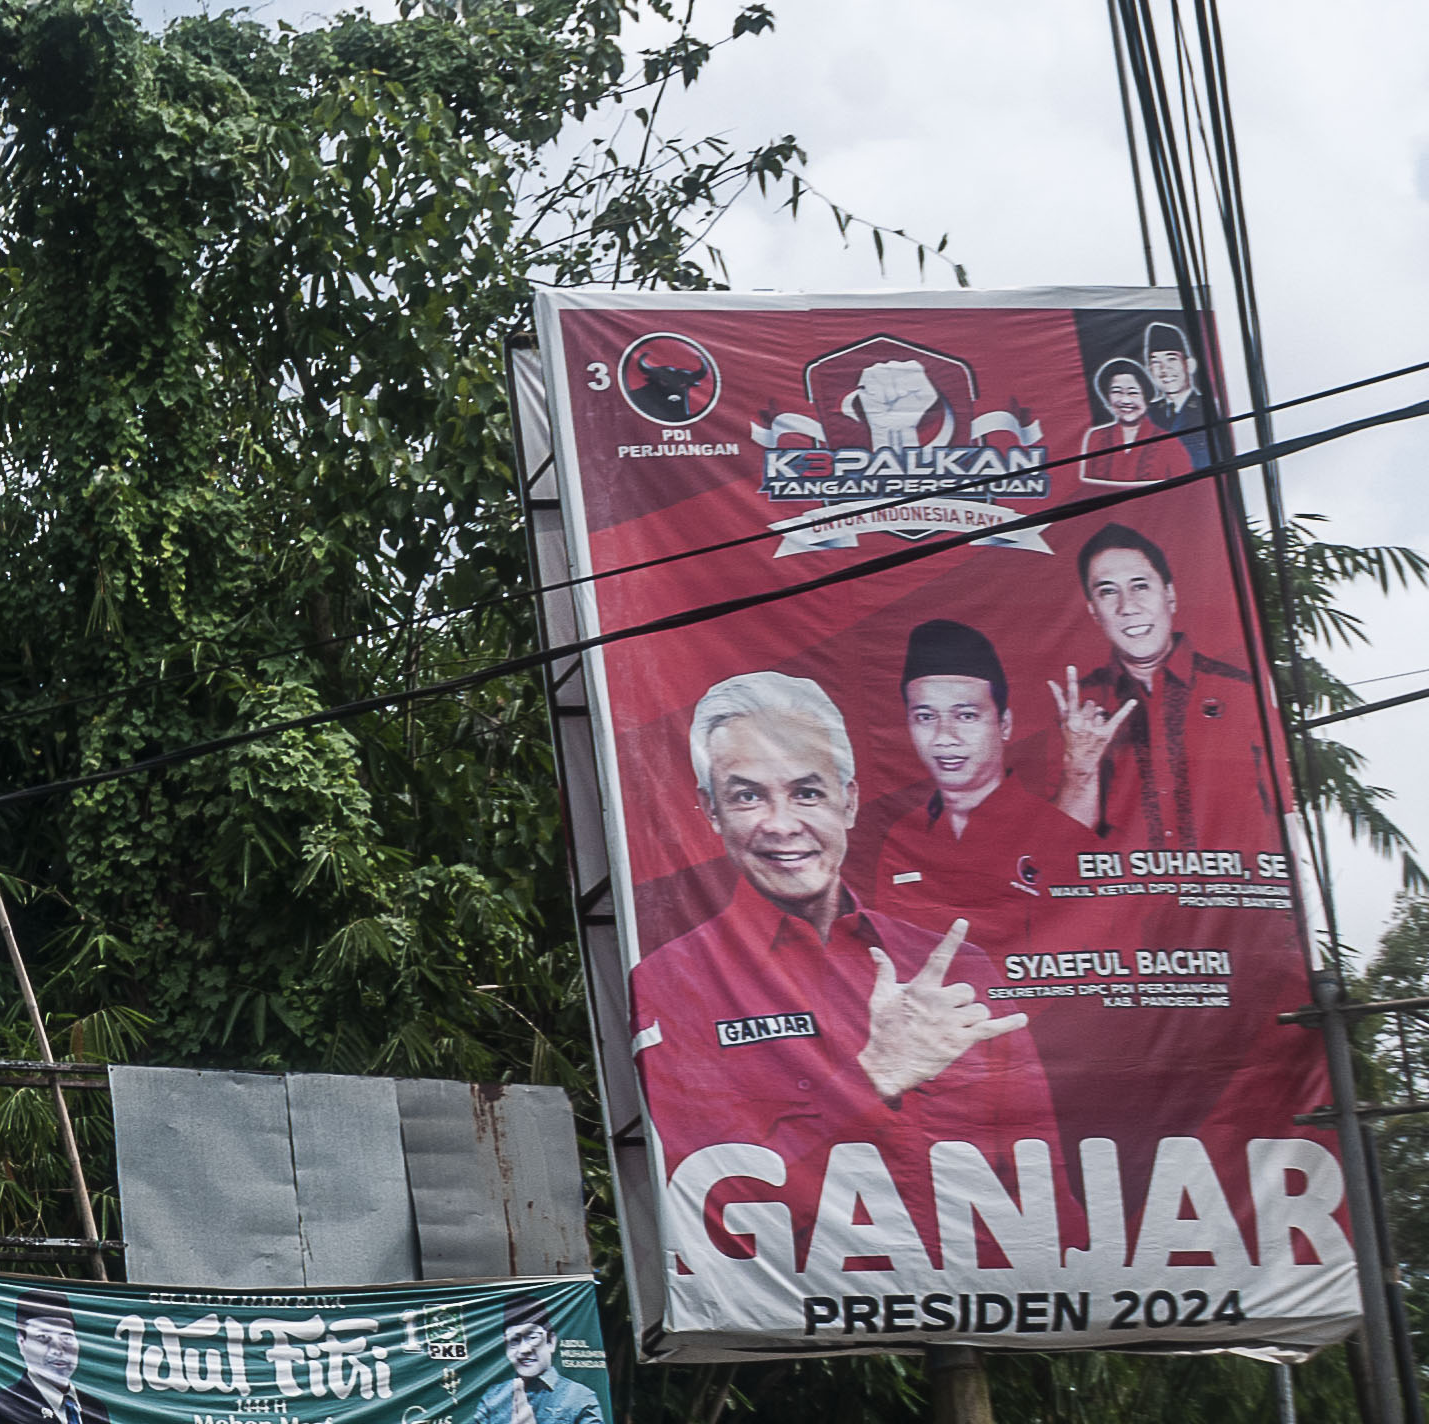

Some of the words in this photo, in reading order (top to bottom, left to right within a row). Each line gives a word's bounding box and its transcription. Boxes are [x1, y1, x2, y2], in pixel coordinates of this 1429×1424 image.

[586, 362, 612, 392] 3
[661, 428, 692, 442] PDI
[618, 443, 740, 458] PERJUANGAN
[770, 480, 878, 495] TANGAN
[871, 507, 960, 524] INDONESIA
[1078, 852, 1123, 879] ERI
[1130, 851, 1252, 880] SUHAERI,
[1258, 853, 1290, 879] SE
[1049, 886, 1095, 897] WAKIL
[1097, 884, 1146, 896] KETUA
[1148, 883, 1178, 895] DPD
[1180, 883, 1203, 895] PDI
[1205, 884, 1291, 897] PERJUANGAN
[1179, 896, 1239, 907] PROVINSI
[1242, 897, 1292, 909] BANTEN
[1005, 951, 1131, 979] SYAEFUL
[1136, 950, 1232, 976] BACHRI
[988, 986, 1075, 999] SEKRETARIS
[1078, 984, 1109, 996] DPC
[1111, 984, 1135, 995] PDI
[1138, 983, 1229, 994] PERJUANGAN
[1103, 996, 1137, 1007] KAB.
[1141, 996, 1231, 1007] PANDEGLANG
[724, 1015, 811, 1043] GANJAR
[668, 1137, 1354, 1276] GANJAR
[803, 1291, 1091, 1336] PRESIDEN
[1110, 1290, 1247, 1331] 2024
[114, 1313, 252, 1397] Idul
[249, 1314, 393, 1400] Fitri
[428, 1343, 468, 1359] PKB
